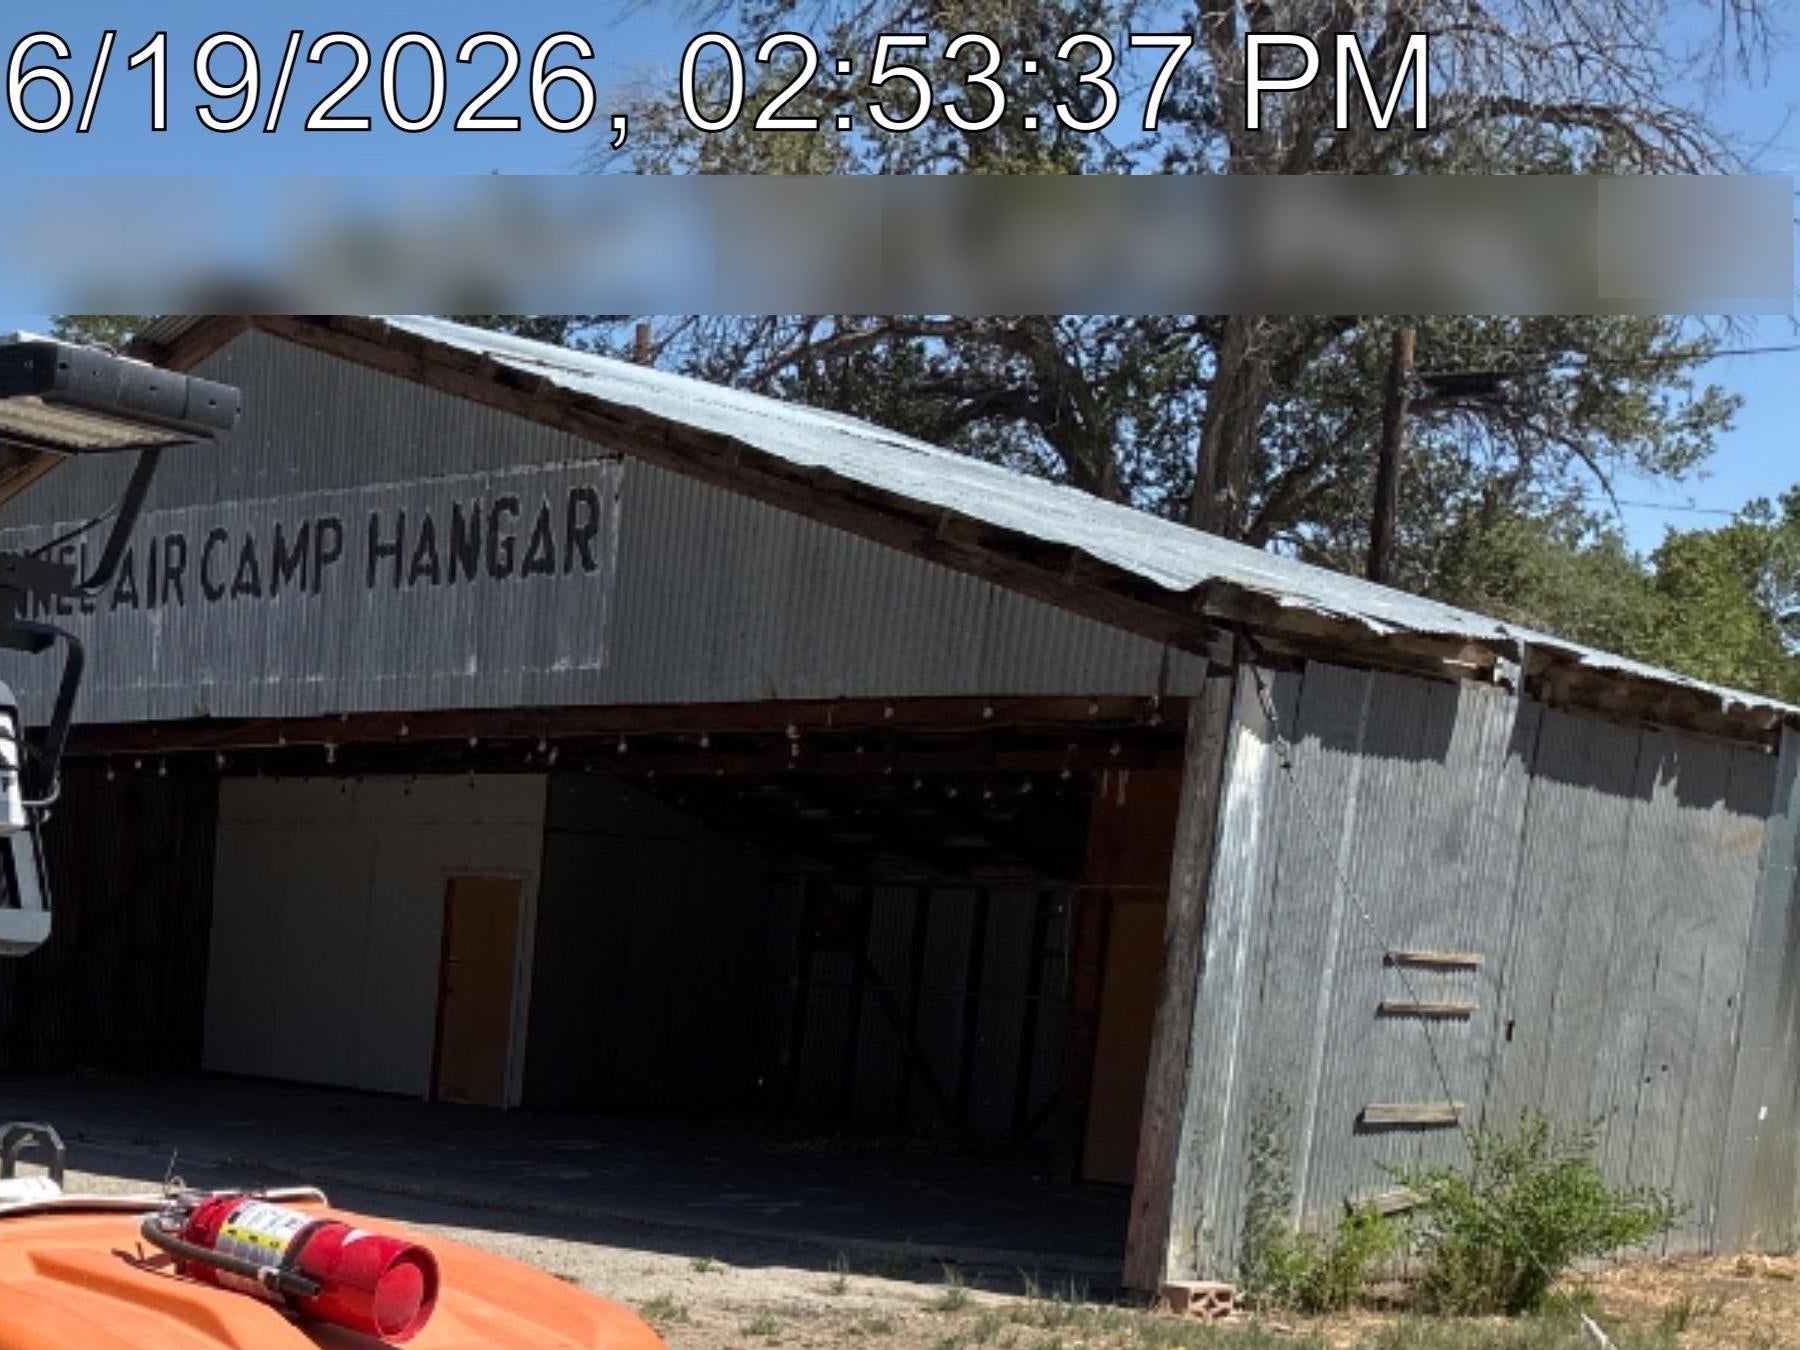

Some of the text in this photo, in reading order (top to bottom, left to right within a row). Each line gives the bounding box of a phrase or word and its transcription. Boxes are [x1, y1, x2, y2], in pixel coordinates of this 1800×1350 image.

[111, 533, 188, 613] AIR
[200, 515, 344, 602] CAMP
[367, 485, 601, 589] HANGAR
